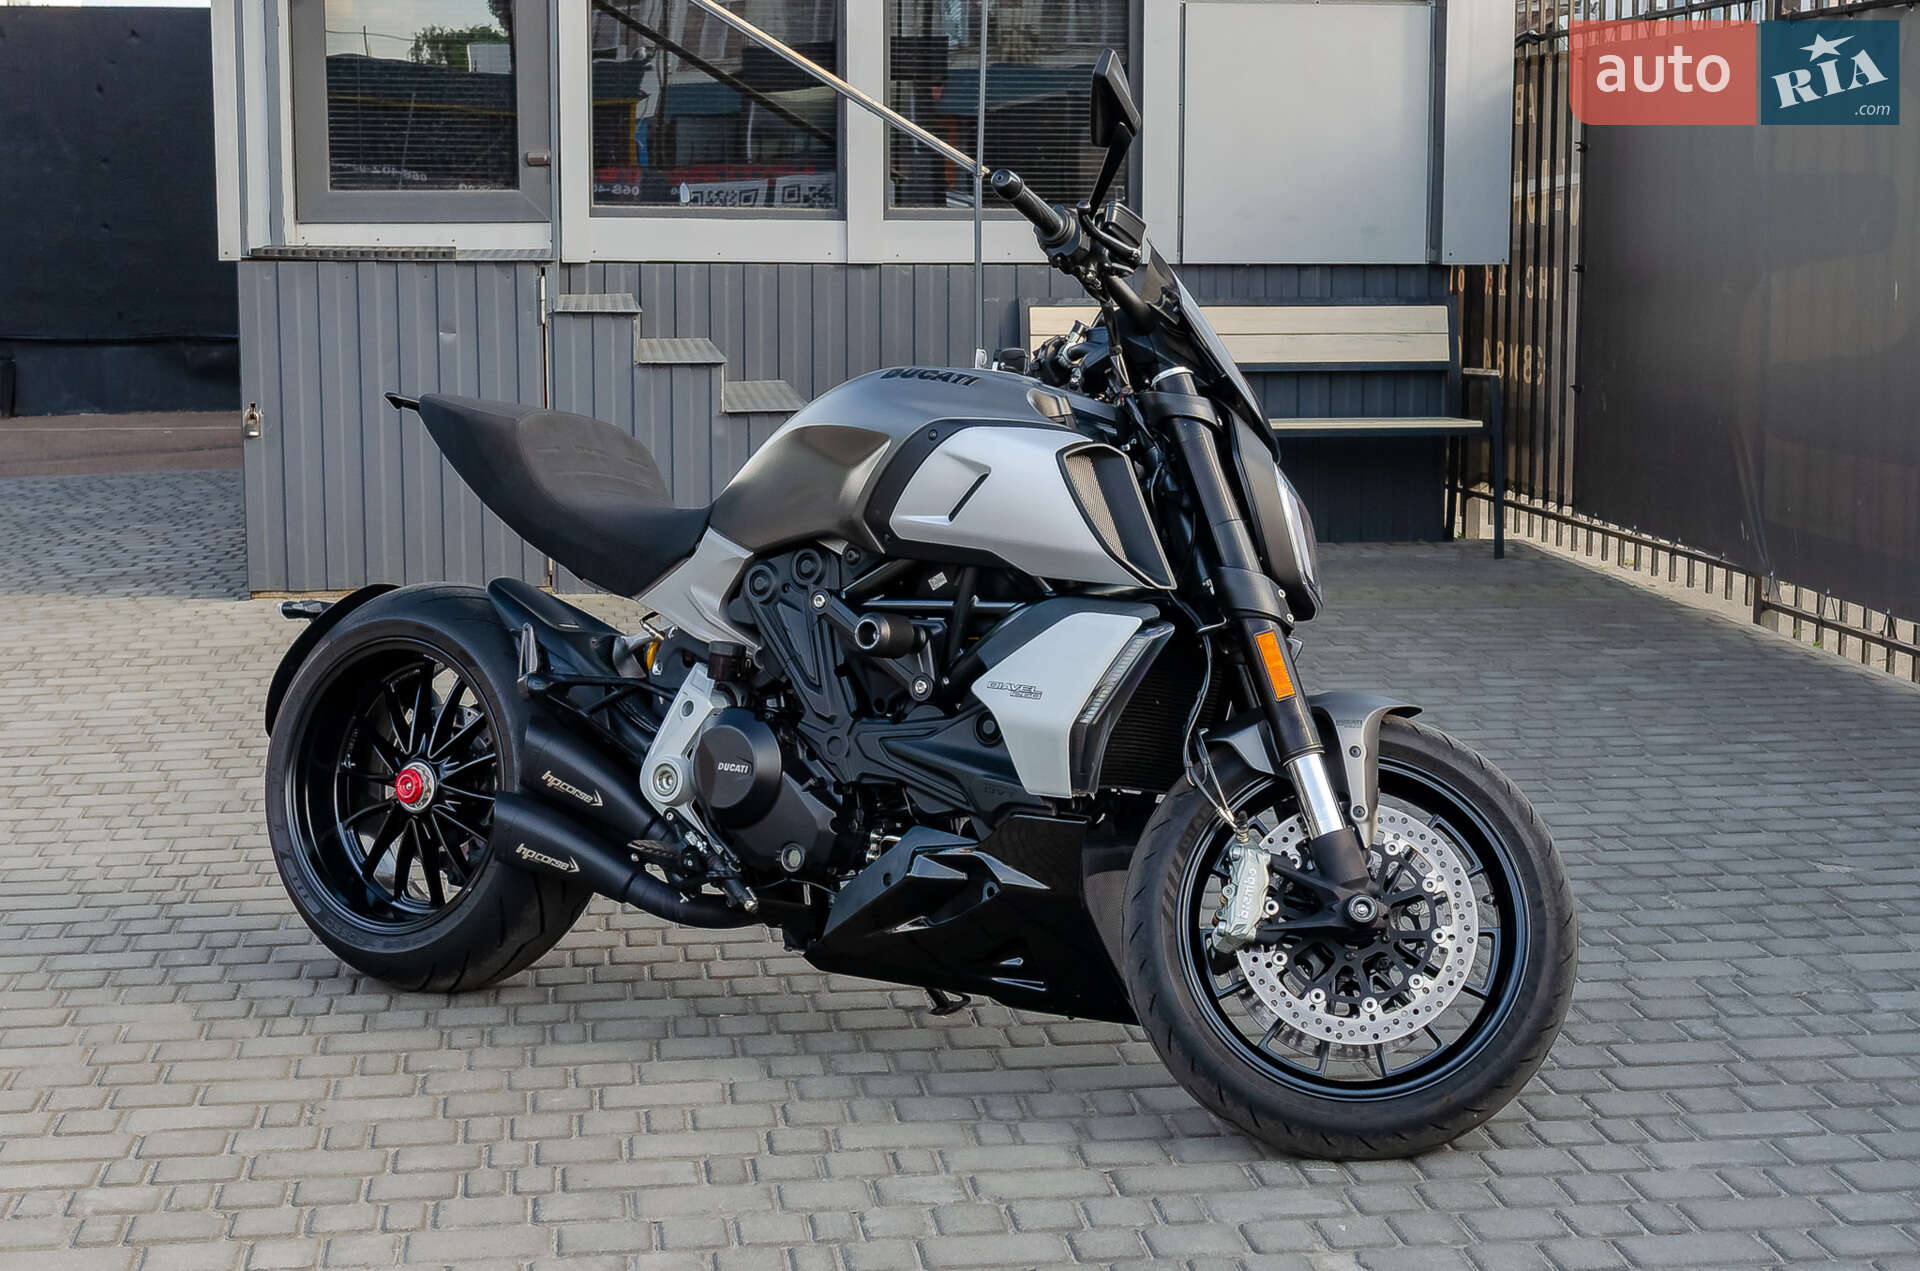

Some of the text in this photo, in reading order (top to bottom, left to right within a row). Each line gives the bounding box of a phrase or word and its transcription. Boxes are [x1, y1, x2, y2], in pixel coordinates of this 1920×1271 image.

[880, 368, 981, 386] DUCATI
[986, 680, 1040, 693] DIAVEL
[717, 762, 749, 774] DUCATI
[1237, 868, 1257, 919] brembo
